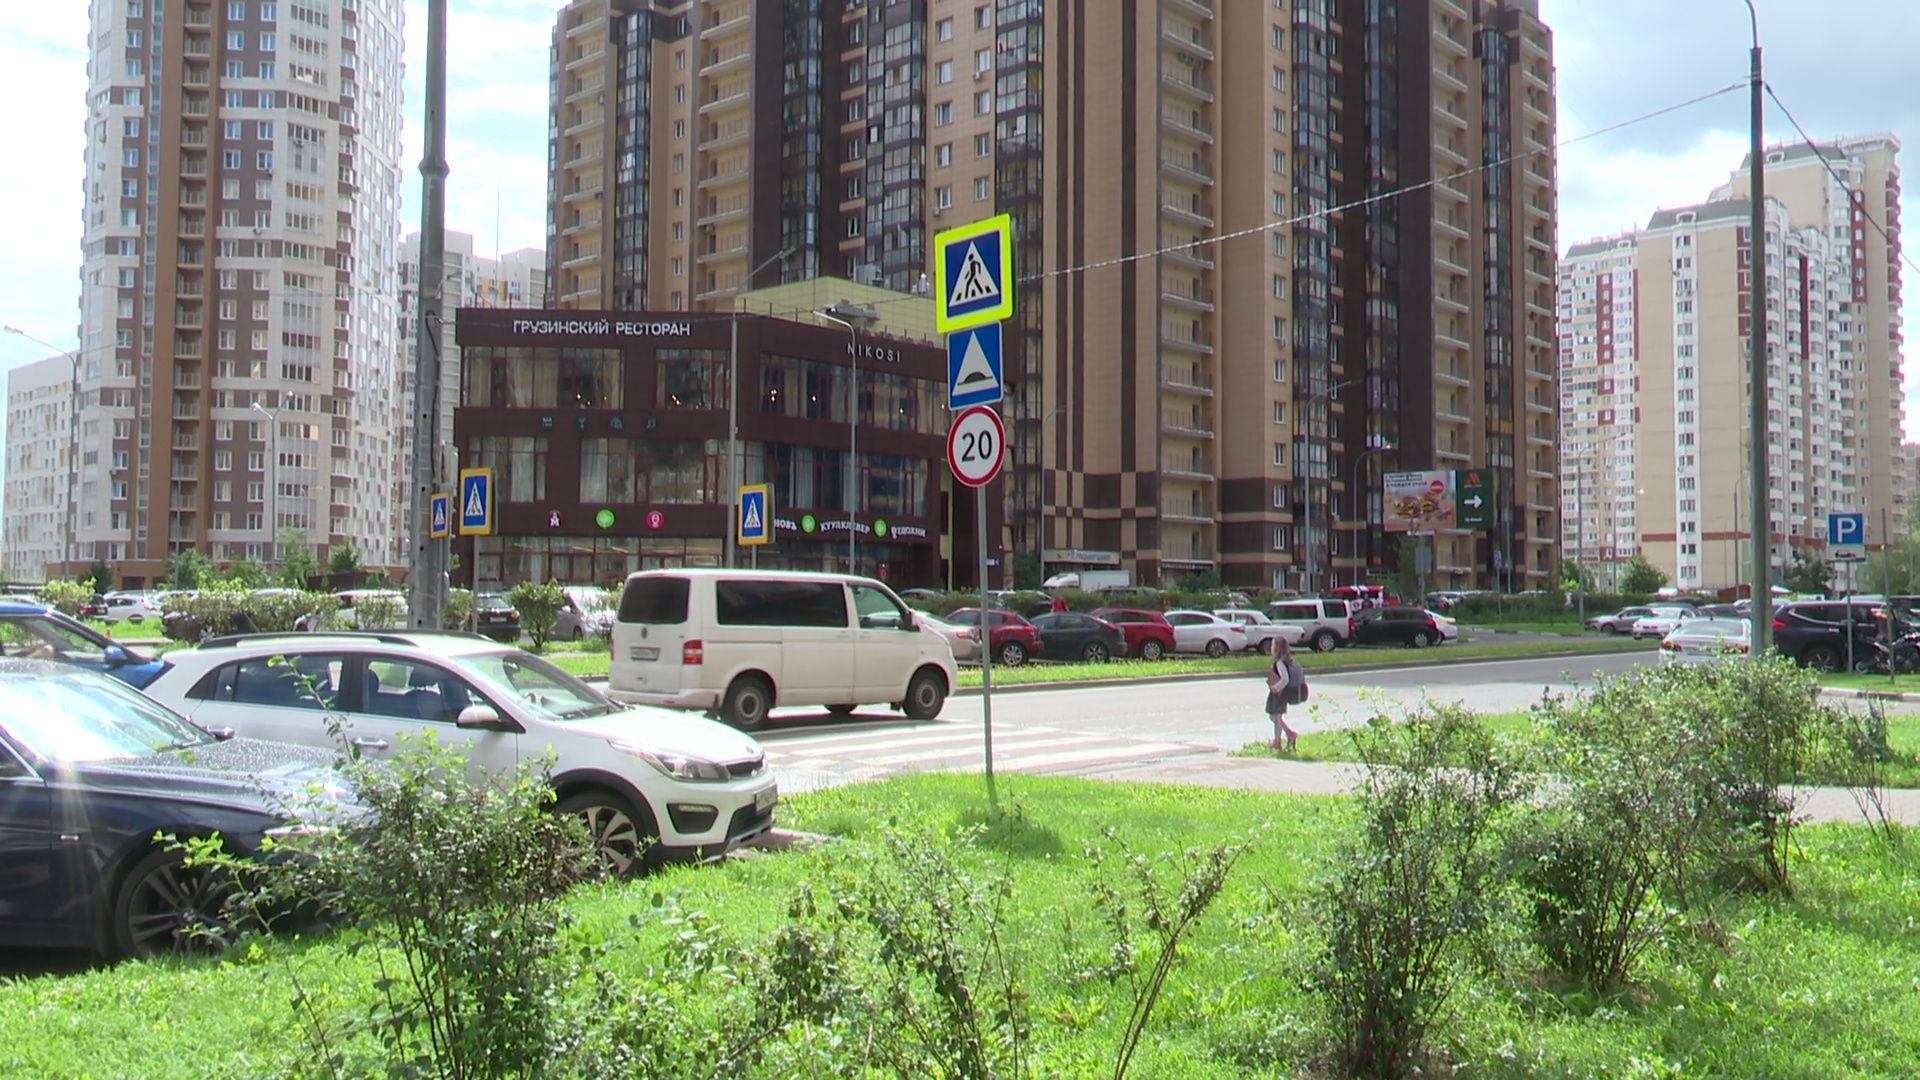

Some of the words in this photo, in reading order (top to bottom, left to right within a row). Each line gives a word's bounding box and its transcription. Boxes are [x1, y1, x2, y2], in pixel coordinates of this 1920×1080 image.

[512, 318, 610, 336] ГРУЗИНСКИЙ
[615, 321, 692, 336] РЕСТОРАН
[847, 342, 900, 363] NIKOSI
[961, 429, 993, 463] 20
[774, 518, 798, 530] НОВЪ
[820, 520, 870, 535] КУУЛКЛВЕР
[1837, 517, 1857, 543] P
